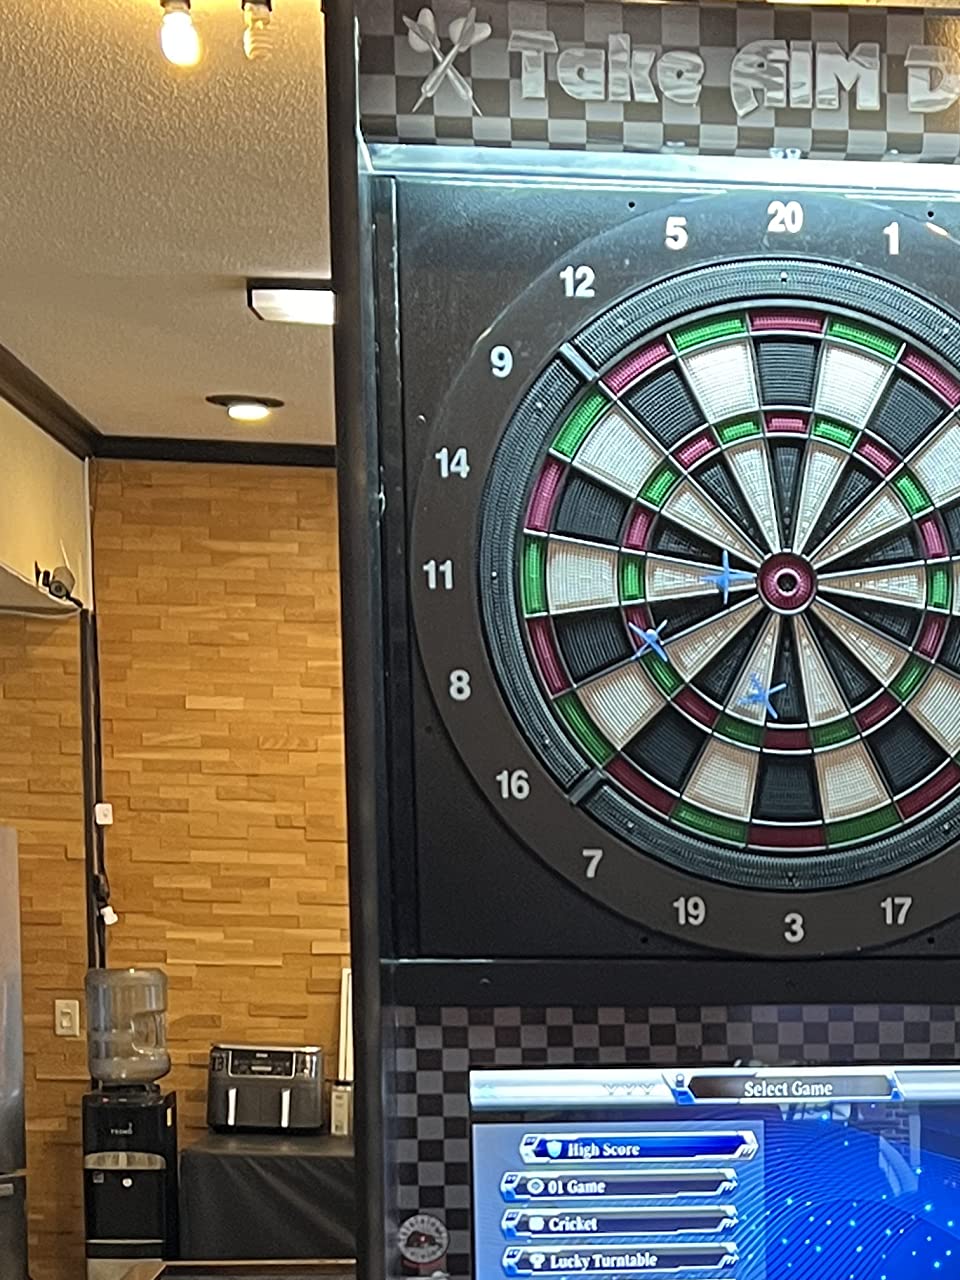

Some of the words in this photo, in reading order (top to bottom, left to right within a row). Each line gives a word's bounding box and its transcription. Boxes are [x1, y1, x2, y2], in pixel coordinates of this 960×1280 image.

[507, 30, 705, 109] Take
[767, 200, 804, 233] 20
[665, 216, 689, 250] 5
[883, 222, 900, 255] 1
[560, 266, 596, 298] 12
[490, 346, 513, 378] 9
[435, 447, 470, 479] 14
[423, 560, 454, 590] 11
[450, 669, 471, 700] 8
[496, 770, 530, 800] 16
[582, 848, 603, 878] 7
[673, 896, 706, 925] 19
[881, 896, 912, 925] 17
[784, 912, 804, 942] 3
[744, 1080, 787, 1097] Select
[791, 1080, 833, 1097] Game
[567, 1142, 600, 1160] High
[602, 1142, 640, 1157] Score
[567, 1179, 606, 1194] Game
[548, 1216, 598, 1232] Cricket
[550, 1253, 590, 1271] Lucky
[592, 1252, 658, 1268] Turntable
